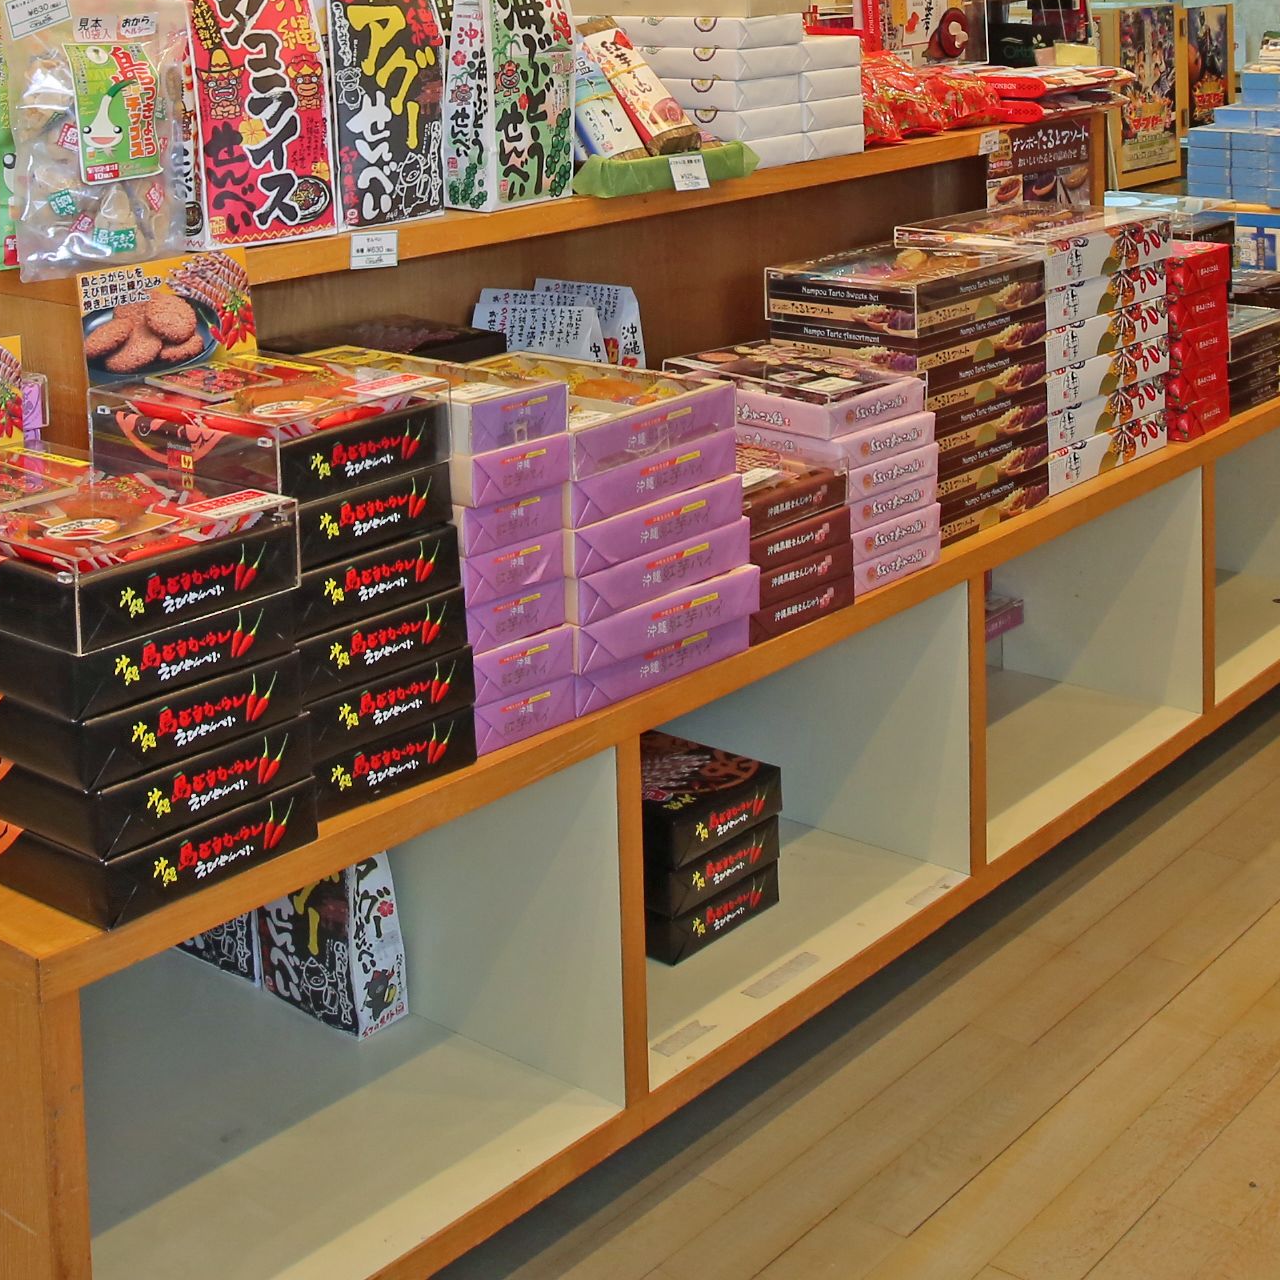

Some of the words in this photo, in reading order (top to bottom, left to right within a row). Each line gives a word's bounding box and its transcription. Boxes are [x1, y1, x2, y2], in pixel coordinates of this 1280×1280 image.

[78, 17, 103, 31] 見本
[347, 5, 436, 149] アグー
[451, 107, 471, 157] せんべい
[1013, 125, 1089, 152] ナンポーたるとアソート
[346, 90, 394, 221] せんべい
[496, 101, 530, 201] せんべい
[204, 121, 256, 234] せんべい
[81, 268, 143, 287] 島とうがらしを
[82, 277, 162, 299] えび煎餅に練り込み
[83, 293, 151, 311] 焼き上げました。
[621, 323, 641, 356] 沖縄
[311, 453, 331, 478] 沖縄
[331, 436, 401, 467] 島とうがらし
[345, 454, 393, 480] えびせんべい
[320, 513, 339, 539] 沖縄
[340, 495, 408, 527] 島とうがらし
[353, 513, 400, 536] えびせんべい
[145, 564, 234, 602] 島とうがらし
[325, 579, 344, 604] 沖縄
[345, 560, 416, 592] 島とうがらし
[358, 577, 407, 601] えびせんべい
[120, 587, 144, 618] 沖縄
[163, 585, 225, 614] えびせんべい
[140, 631, 231, 671] 島とうがらし
[350, 621, 421, 656] 島とうがらし
[364, 640, 413, 665] えびせんべい
[115, 654, 140, 686] 沖縄
[158, 652, 220, 680] えびせんべい
[330, 643, 350, 669] 沖縄
[359, 680, 430, 717] 島とうがらし
[373, 699, 422, 725] えびせんべい
[157, 698, 246, 736] 島とうがらし
[174, 716, 236, 746] えびせんべい
[339, 704, 359, 729] 沖縄
[132, 721, 156, 752] 沖縄
[352, 742, 428, 778] 島とうがらし
[367, 760, 419, 786] えびせんべい
[171, 763, 257, 802] 島とうがらし
[331, 766, 352, 790] 沖縄
[147, 787, 171, 818] 沖縄
[188, 780, 249, 812] えびせんべい
[178, 833, 259, 871] 島とうがらし
[195, 845, 254, 878] えびせんべい
[154, 856, 177, 887] 沖縄
